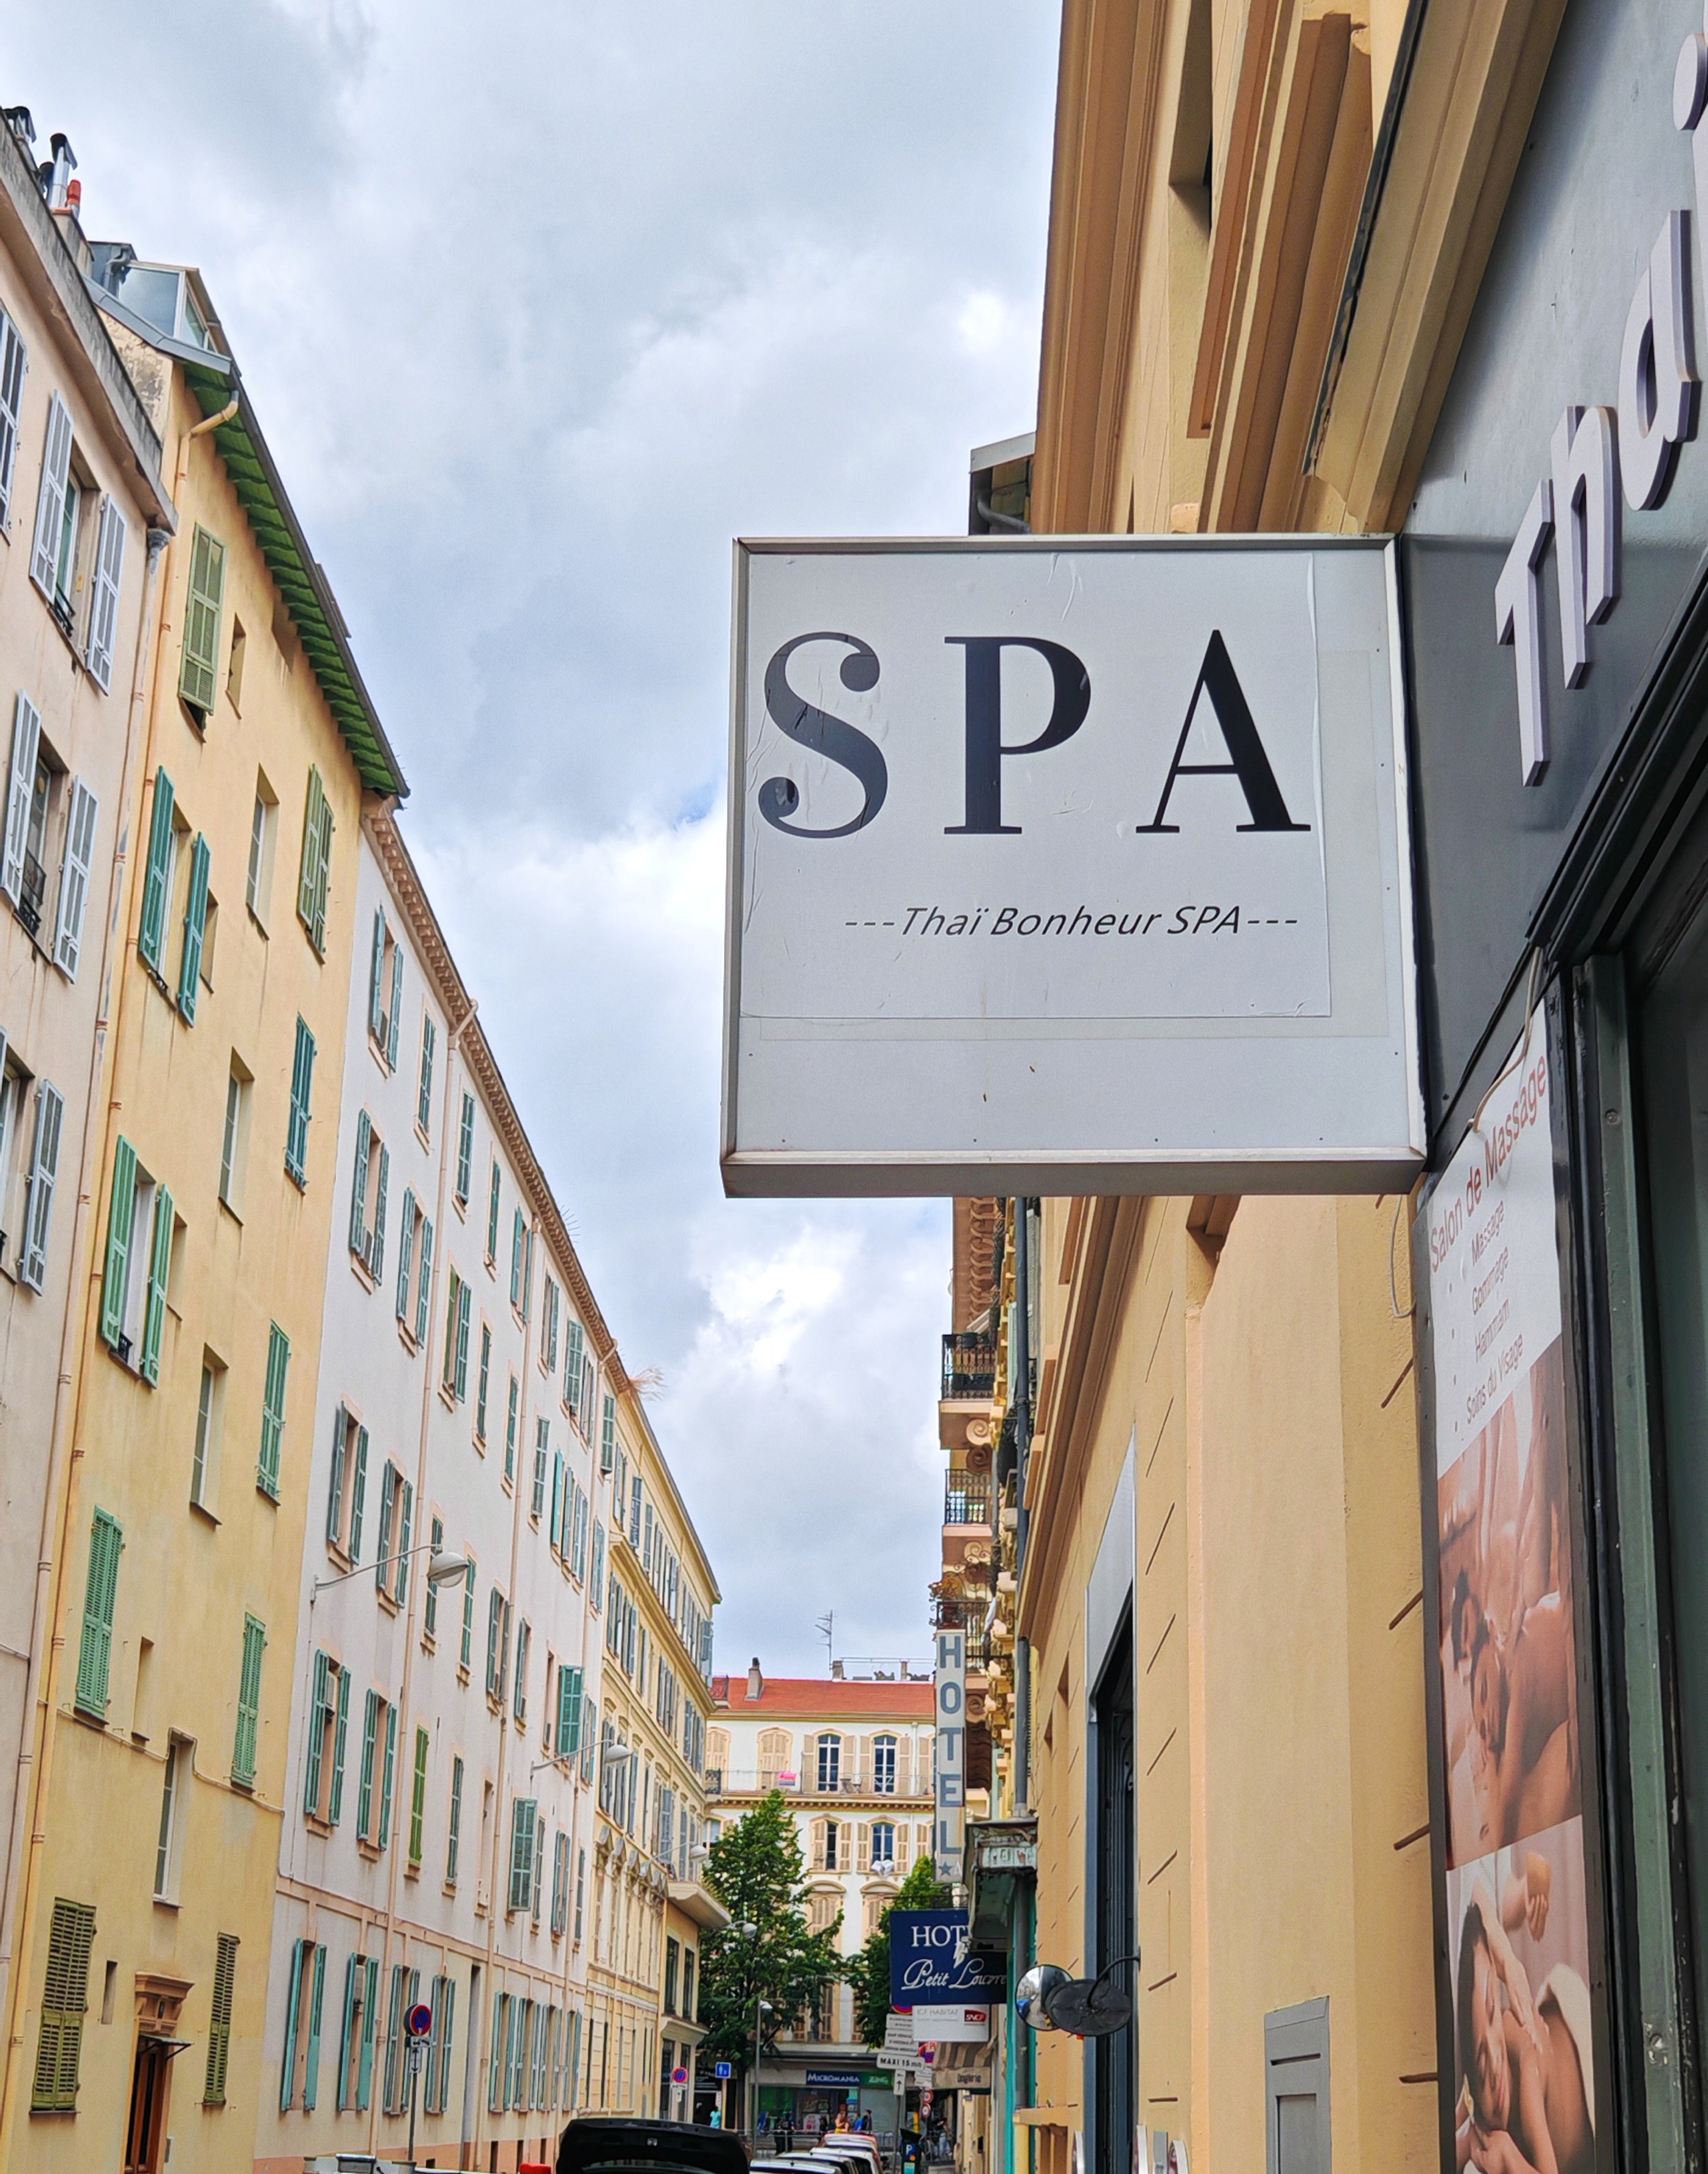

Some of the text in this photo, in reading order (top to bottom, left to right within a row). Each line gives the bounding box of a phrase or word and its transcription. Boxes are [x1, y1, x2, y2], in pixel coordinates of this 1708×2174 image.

[758, 629, 1311, 839] SPA
[990, 905, 1162, 936] Bonheur
[1431, 1055, 1546, 1273] Salon de Massage
[1472, 1200, 1504, 1267] Massage
[1467, 1333, 1523, 1425] Soins du Visage
[939, 1635, 962, 1855] HOTEL
[911, 1925, 971, 1948] HOT
[901, 1958, 1007, 1990] Petit Louvre
[880, 2057, 900, 2066] MAXI
